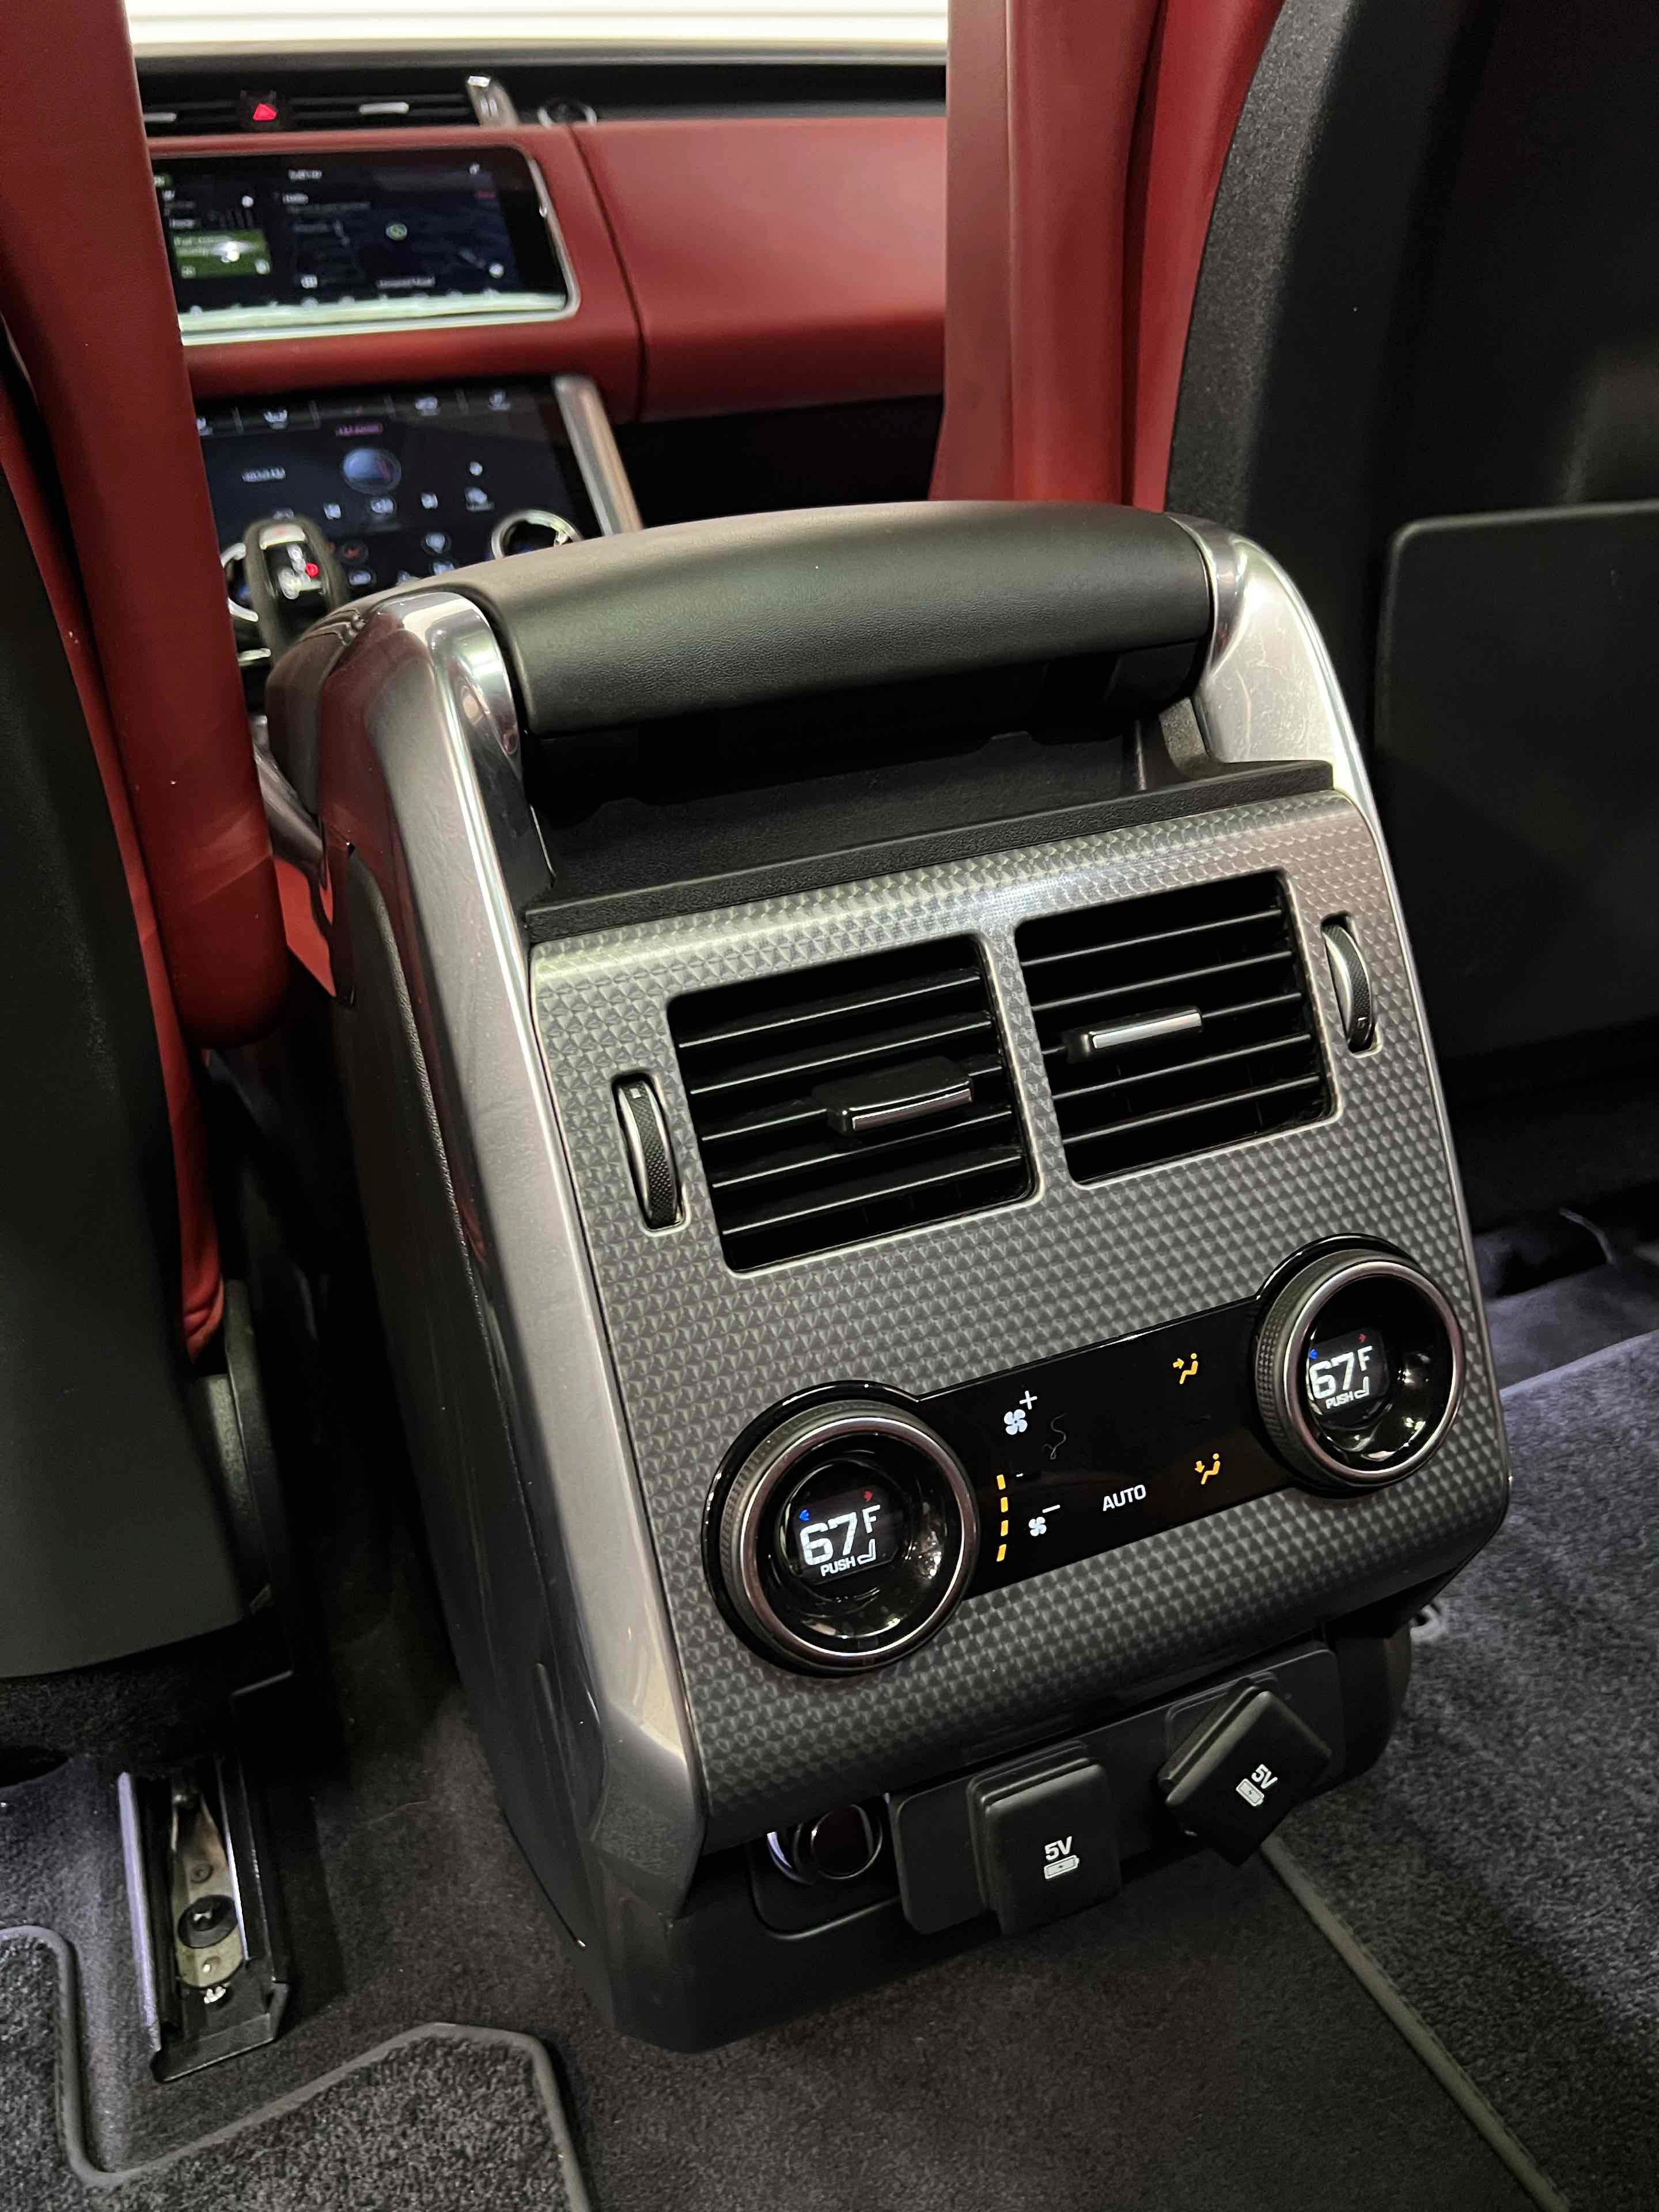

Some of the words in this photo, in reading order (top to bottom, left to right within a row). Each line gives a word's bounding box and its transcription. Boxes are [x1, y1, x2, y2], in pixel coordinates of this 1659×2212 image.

[1325, 1391, 1354, 1409] PUSH
[1103, 1484, 1146, 1512] AUTO
[820, 1555, 856, 1577] PUSH
[1251, 1764, 1278, 1789] 5V
[1044, 1836, 1073, 1861] 5V
